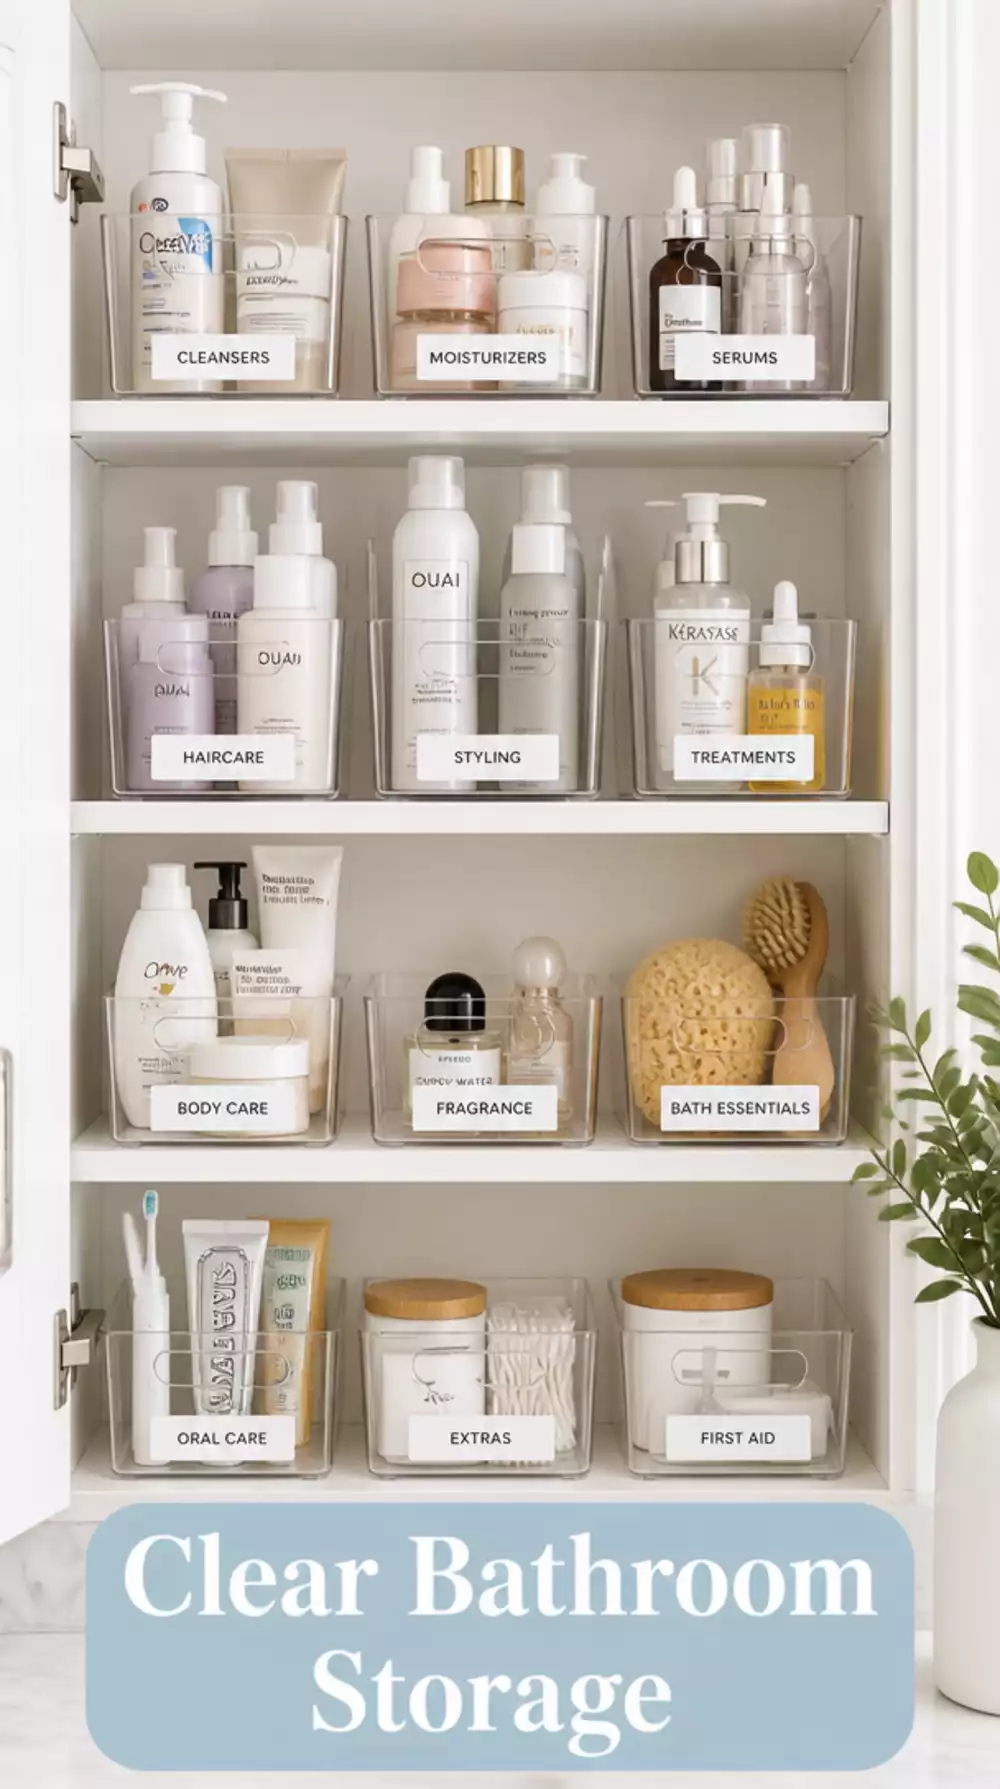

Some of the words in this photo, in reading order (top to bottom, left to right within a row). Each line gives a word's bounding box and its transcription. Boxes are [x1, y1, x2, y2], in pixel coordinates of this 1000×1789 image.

[176, 350, 271, 365] CLEANSERS
[429, 351, 547, 365] MOISTURIZERS
[712, 351, 779, 365] SERUMS
[410, 571, 461, 589] OUAI
[183, 750, 265, 765] HAIRCARE
[454, 750, 522, 765] STYLING
[690, 750, 796, 765] TREATMENTS
[177, 1101, 221, 1116] BODY
[225, 1101, 269, 1116] CARE
[436, 1100, 533, 1116] FRAGRANCE
[670, 1101, 712, 1116] BATH
[716, 1101, 811, 1116] ESSENTIALS
[176, 1431, 221, 1446] ORAL
[224, 1431, 268, 1446] CARE
[450, 1431, 512, 1446] EXTRAS
[700, 1431, 744, 1445] FIRST
[747, 1431, 776, 1445] AID
